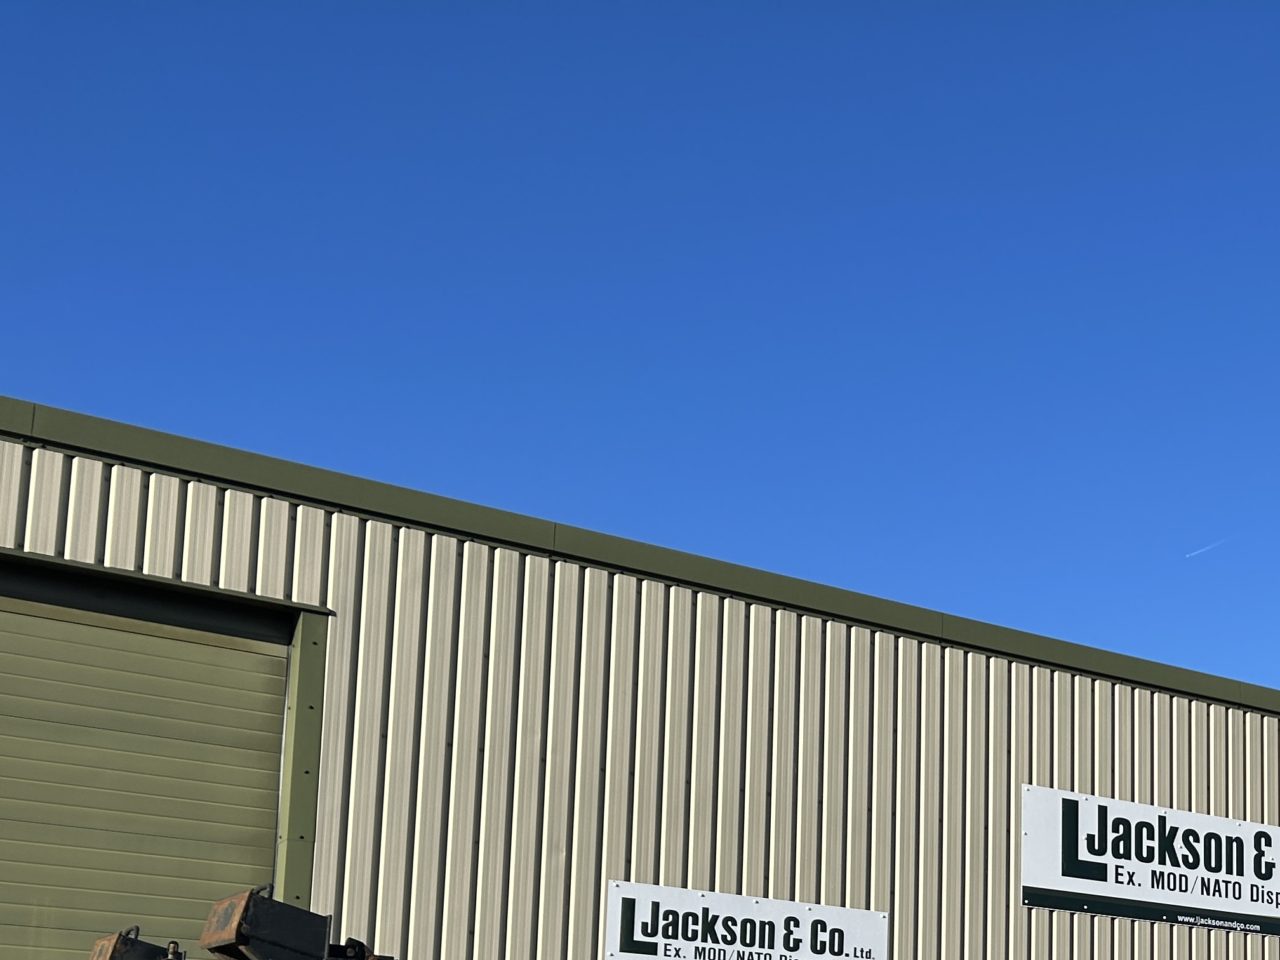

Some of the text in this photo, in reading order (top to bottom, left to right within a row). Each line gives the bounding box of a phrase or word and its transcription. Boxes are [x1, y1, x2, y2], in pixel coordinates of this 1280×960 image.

[1253, 831, 1275, 881] &
[1114, 865, 1142, 887] Ex.
[663, 944, 686, 959] Ex.
[783, 916, 802, 952] &
[810, 919, 850, 957] Co.
[853, 947, 875, 960] Ltd.
